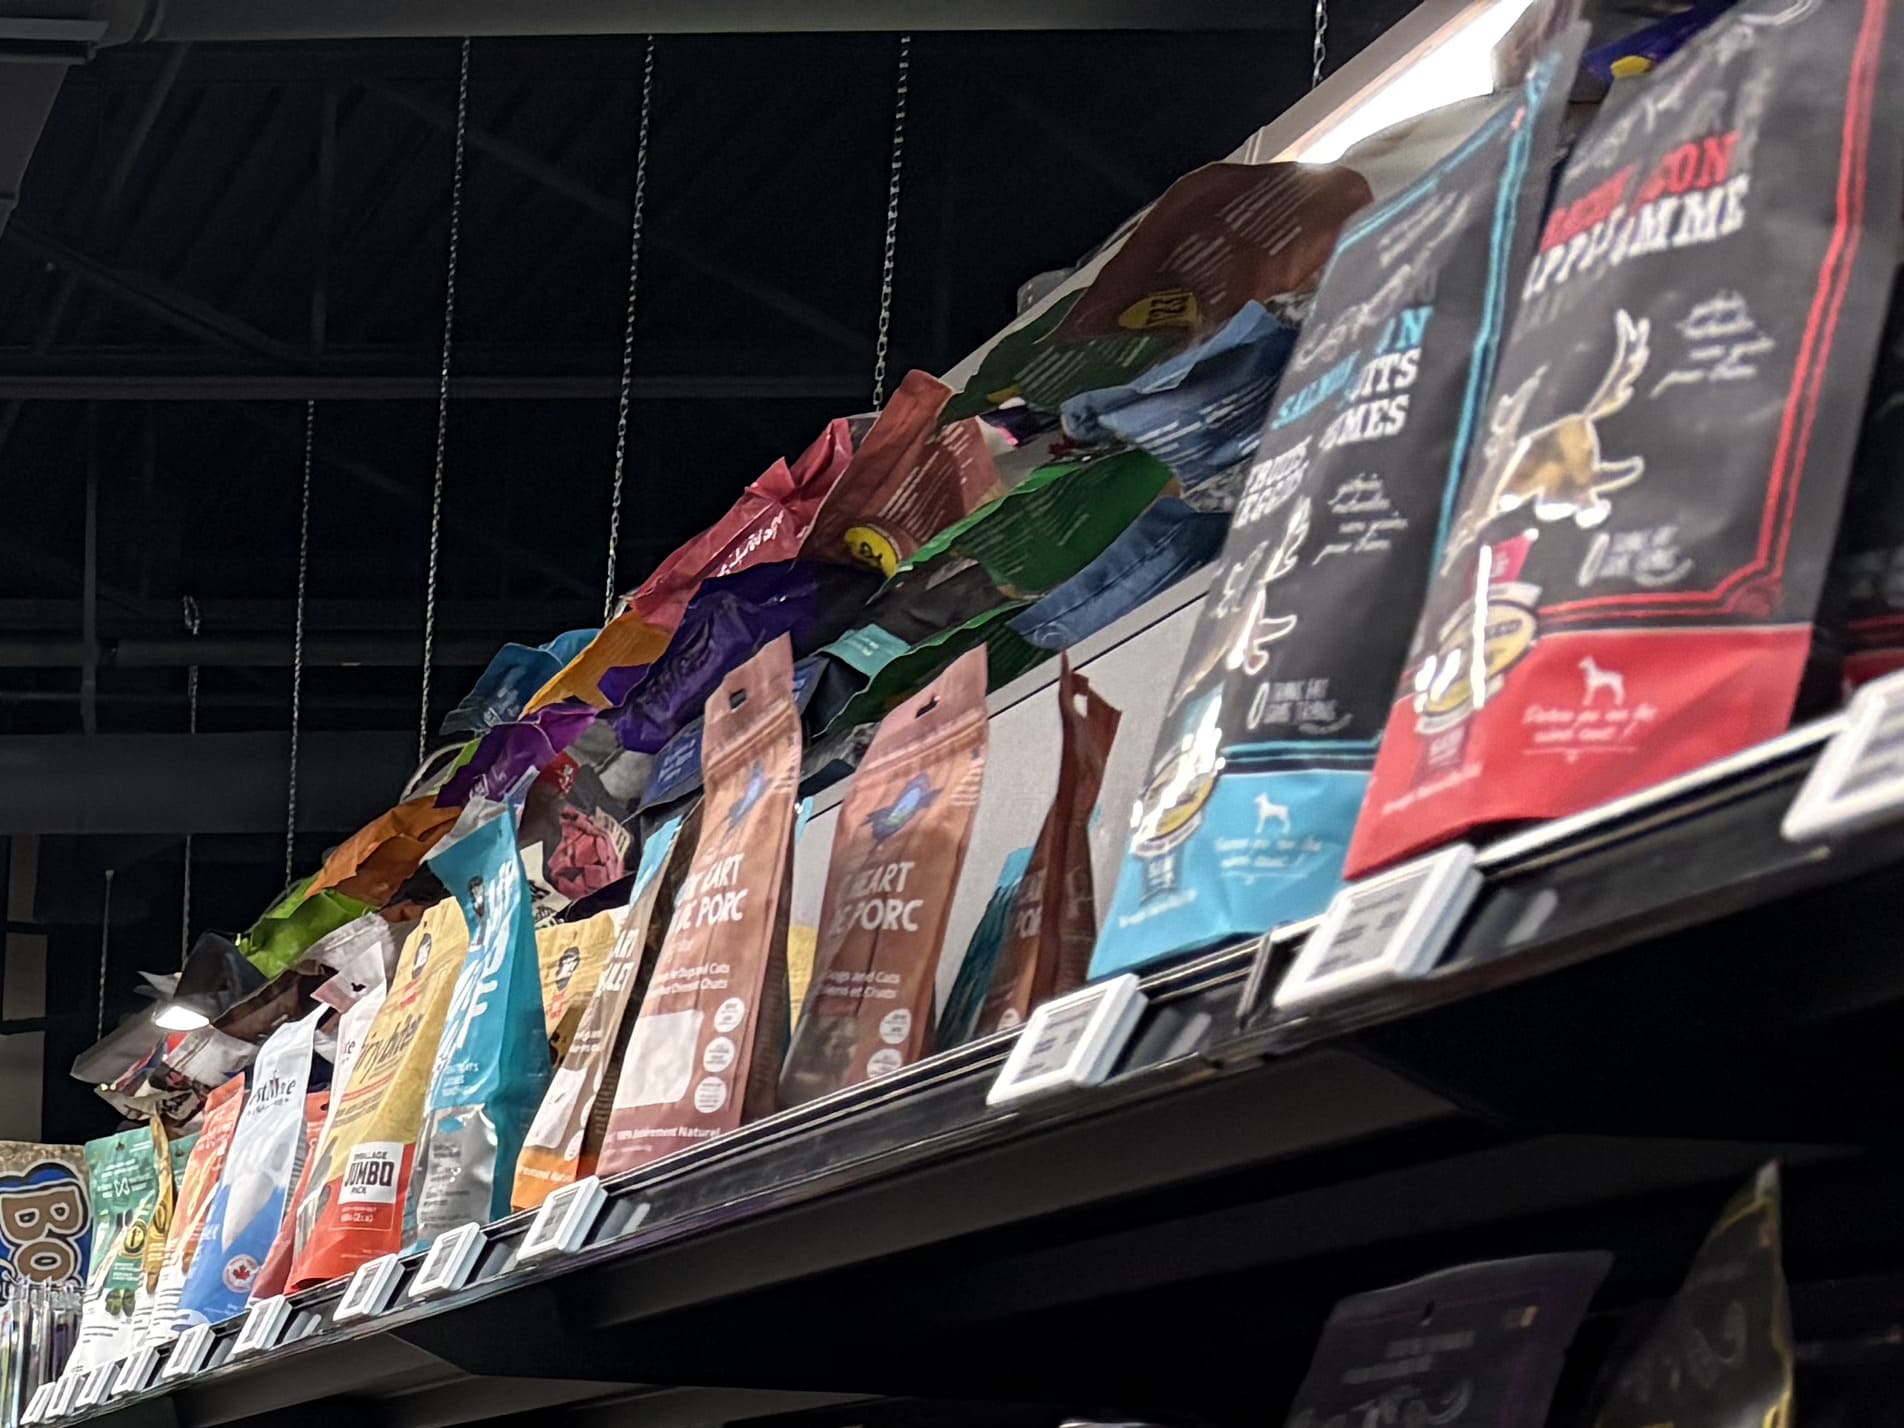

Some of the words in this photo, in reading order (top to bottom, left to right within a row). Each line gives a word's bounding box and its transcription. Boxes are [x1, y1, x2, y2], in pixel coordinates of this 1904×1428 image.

[696, 889, 748, 929] PORC
[679, 1127, 721, 1138] Naturel
[344, 1161, 395, 1187] JUMBO
